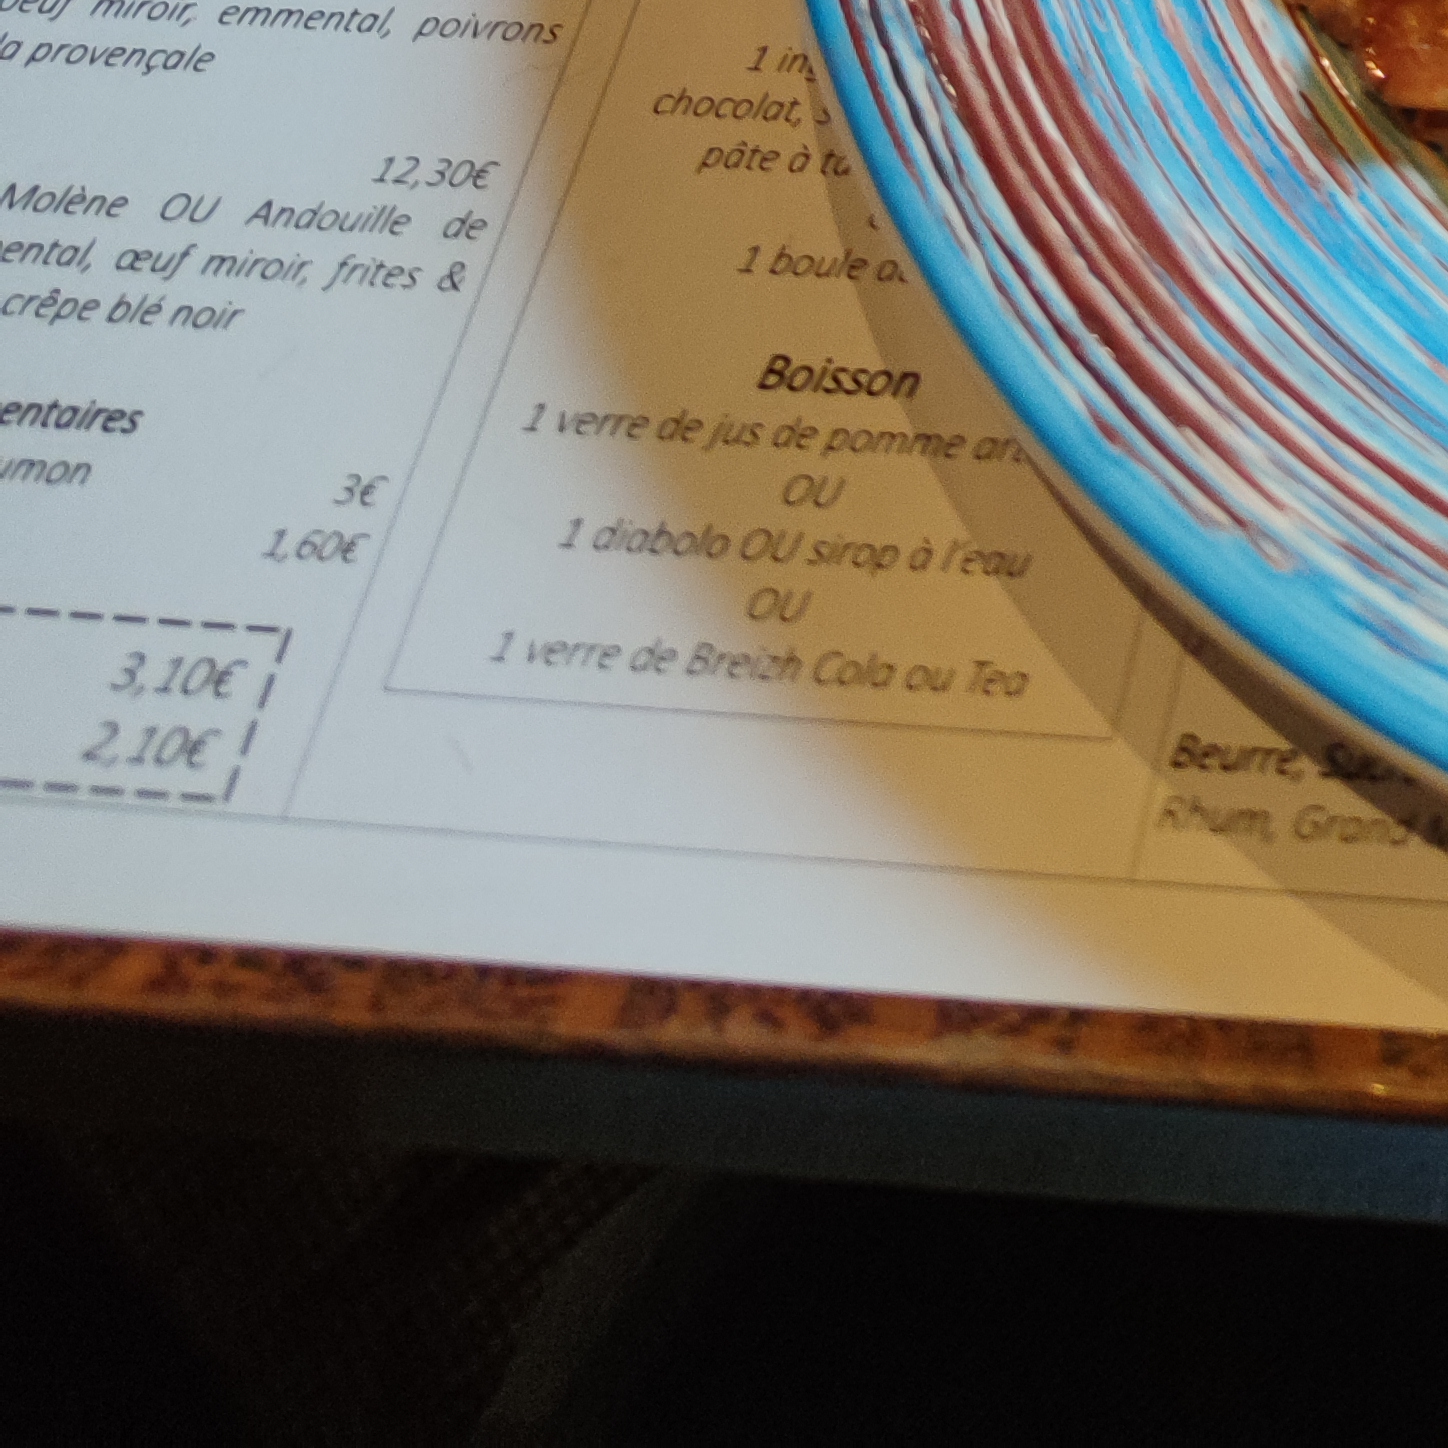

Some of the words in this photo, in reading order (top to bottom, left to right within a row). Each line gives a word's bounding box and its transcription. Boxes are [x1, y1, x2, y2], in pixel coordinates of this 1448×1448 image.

[372, 156, 500, 189] 12,30€
[756, 354, 920, 398] Boisson
[334, 474, 389, 507] 3€
[262, 529, 370, 564] 1,60€
[110, 651, 248, 699] 3,10€
[81, 720, 222, 770] 2,10€
